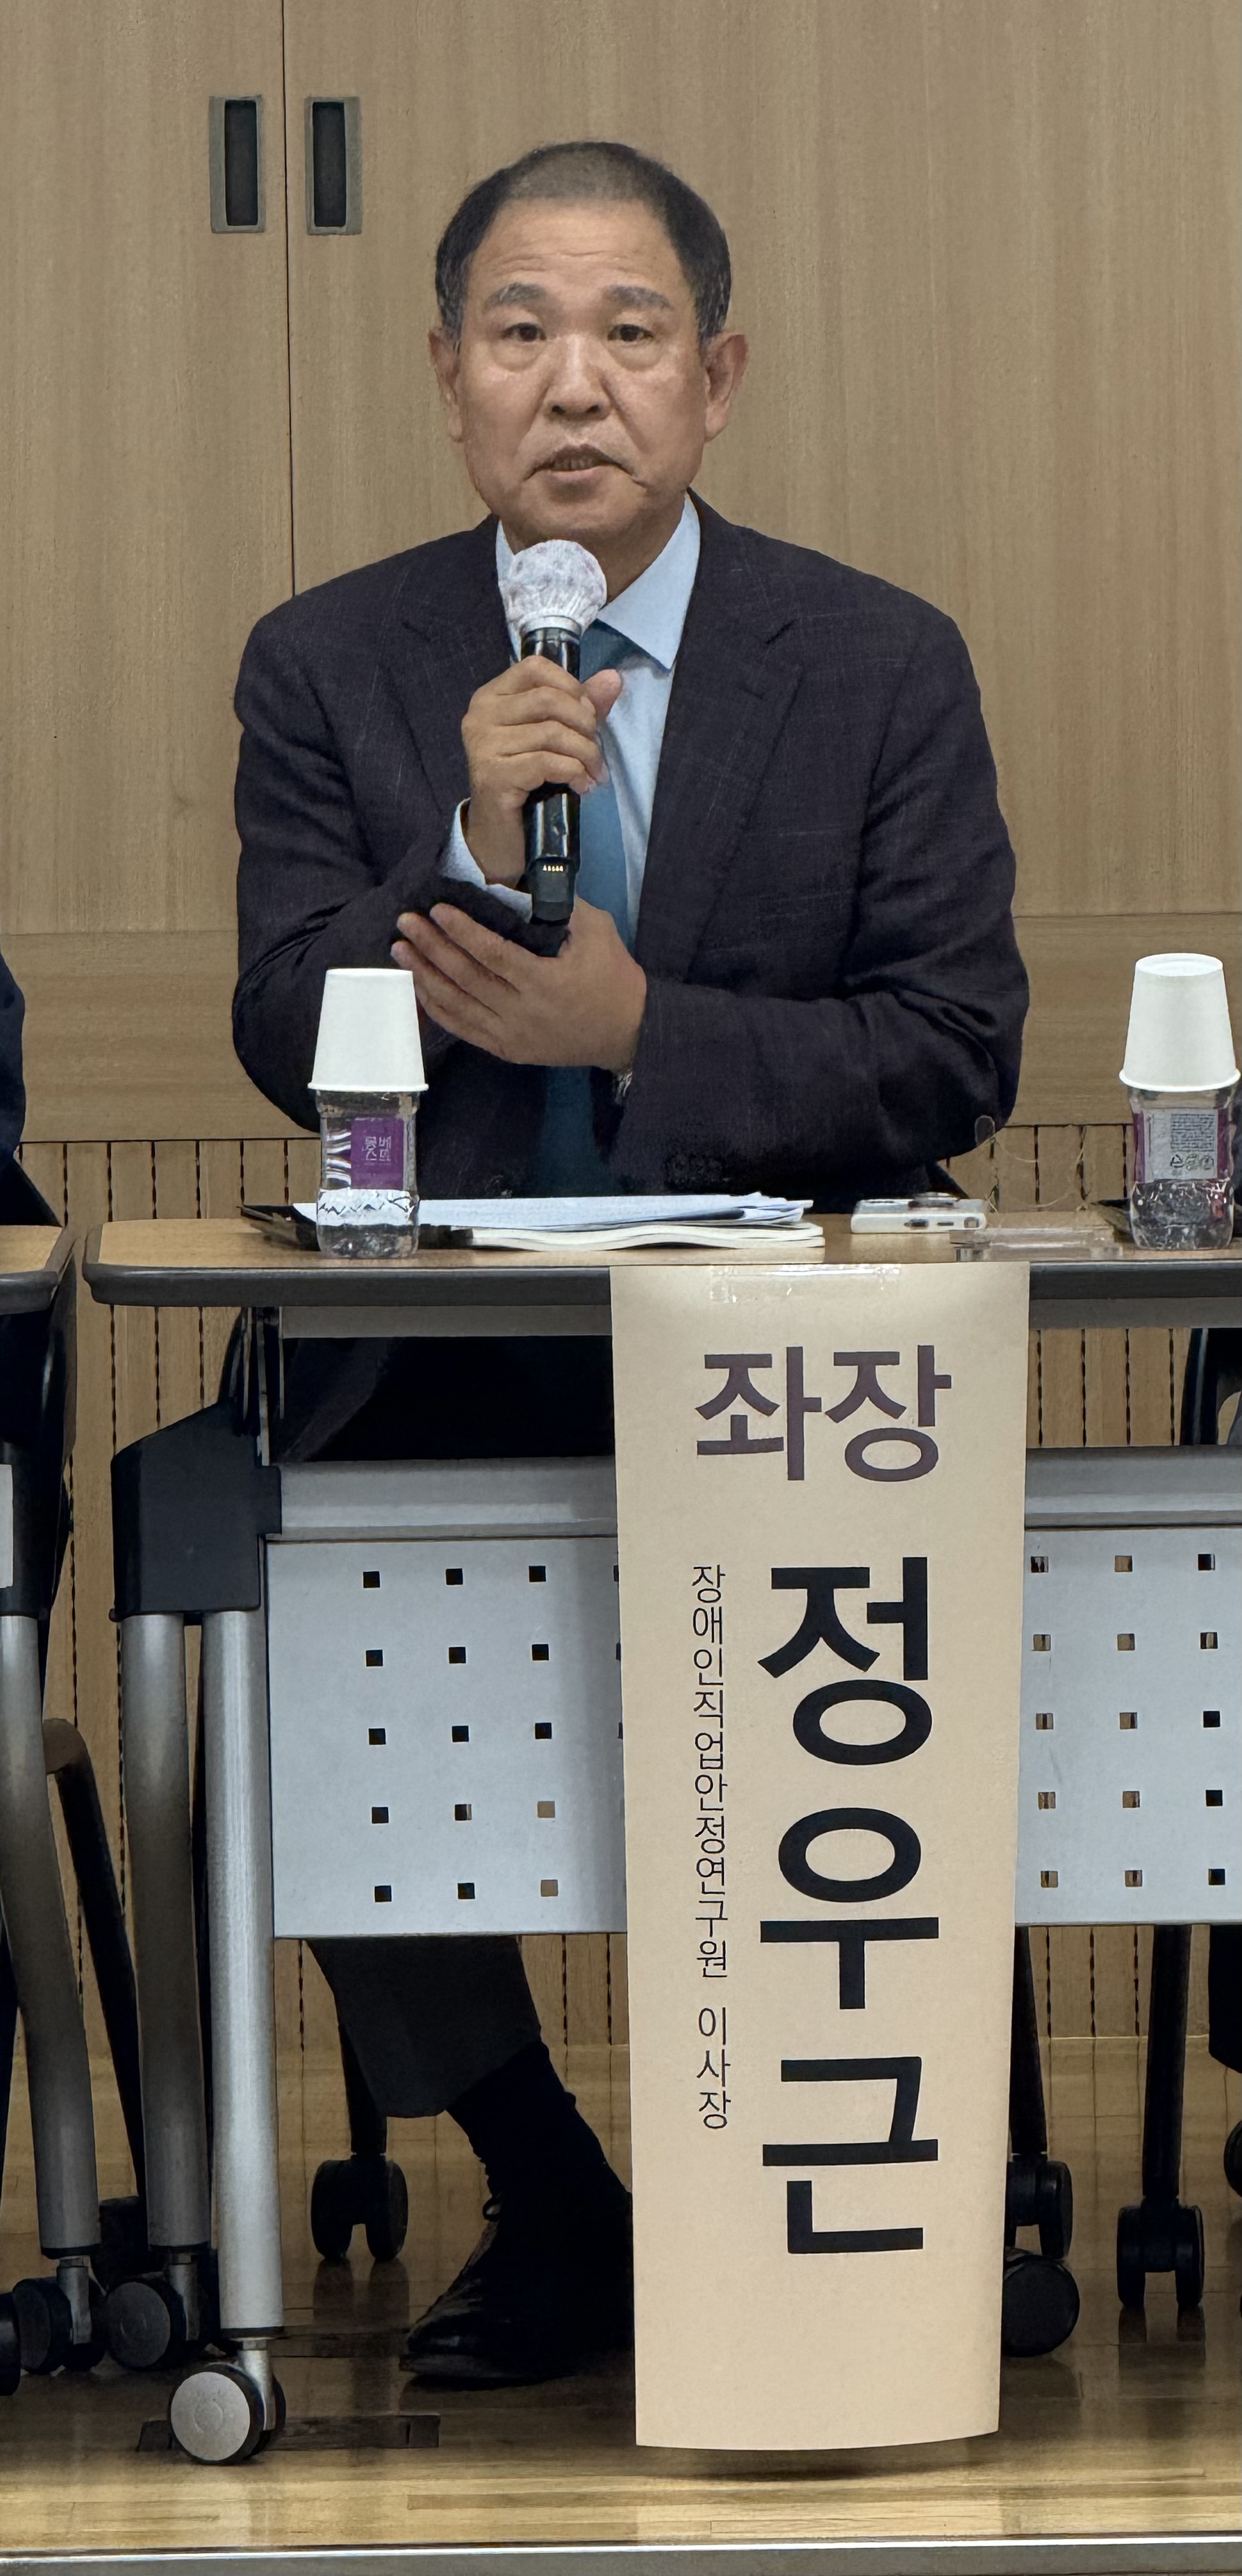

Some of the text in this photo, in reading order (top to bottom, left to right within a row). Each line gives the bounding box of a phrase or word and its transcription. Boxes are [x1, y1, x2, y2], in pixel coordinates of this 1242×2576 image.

[694, 1344, 952, 1482] 좌장
[690, 1564, 731, 2129] 장애인직업안정연구원 이사장
[757, 1556, 939, 2254] 정우근
